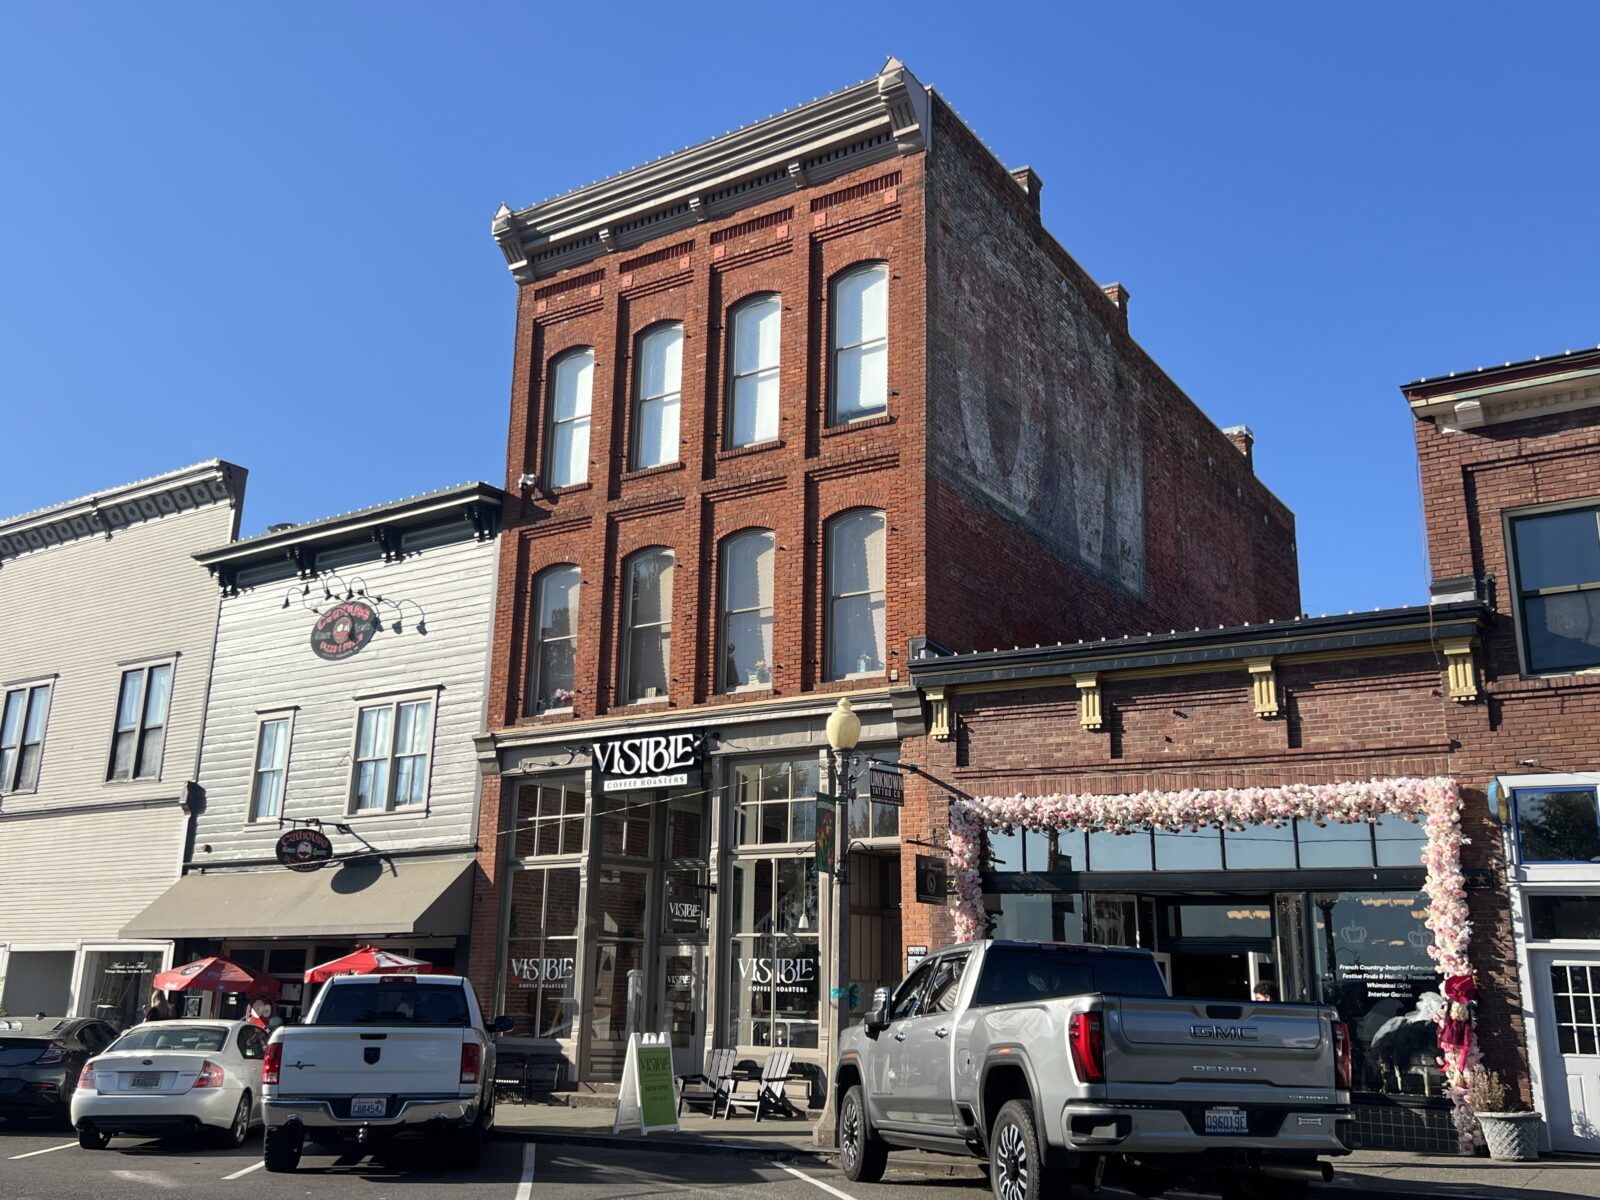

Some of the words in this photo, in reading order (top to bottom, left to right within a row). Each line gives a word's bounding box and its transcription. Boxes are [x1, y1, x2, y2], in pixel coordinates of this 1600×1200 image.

[592, 733, 695, 775] VISIBLE
[606, 780, 638, 789] COFFEE
[640, 775, 685, 786] ROASTERS
[870, 770, 904, 791] UNKNOWN
[669, 902, 700, 918] VISIBLE
[511, 957, 574, 981] VISIBLE
[737, 957, 815, 984] VISIBLE
[1360, 964, 1409, 972] Country-Inspired
[1190, 1025, 1260, 1041] GMC
[1192, 1065, 1257, 1073] DENALI
